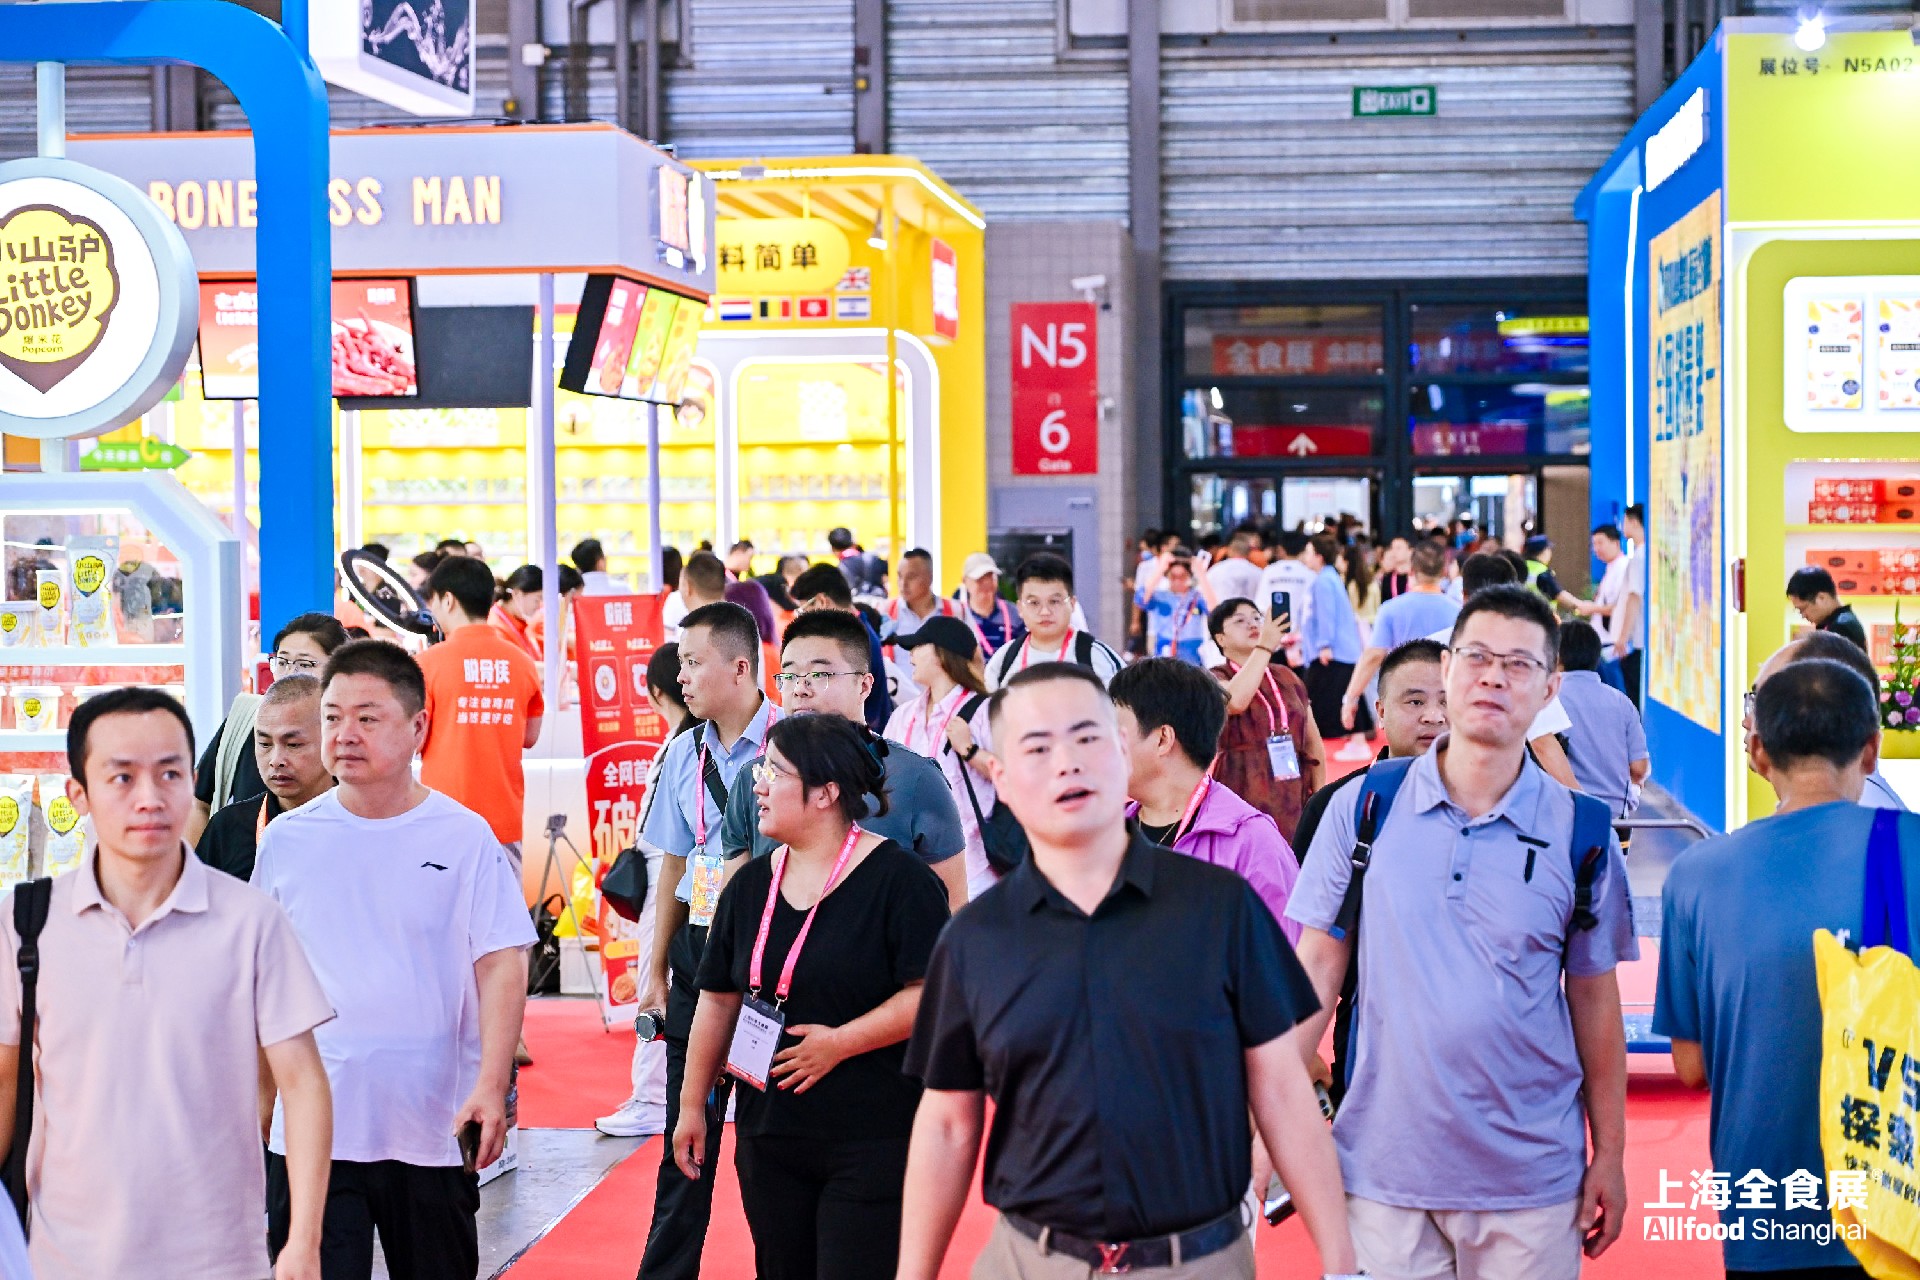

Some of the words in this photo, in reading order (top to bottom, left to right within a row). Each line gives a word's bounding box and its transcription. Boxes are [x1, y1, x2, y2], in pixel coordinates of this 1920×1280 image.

[411, 175, 502, 226] MAN
[22, 345, 64, 354] Popcorn
[1021, 322, 1087, 369] N5
[1039, 408, 1071, 454] 6
